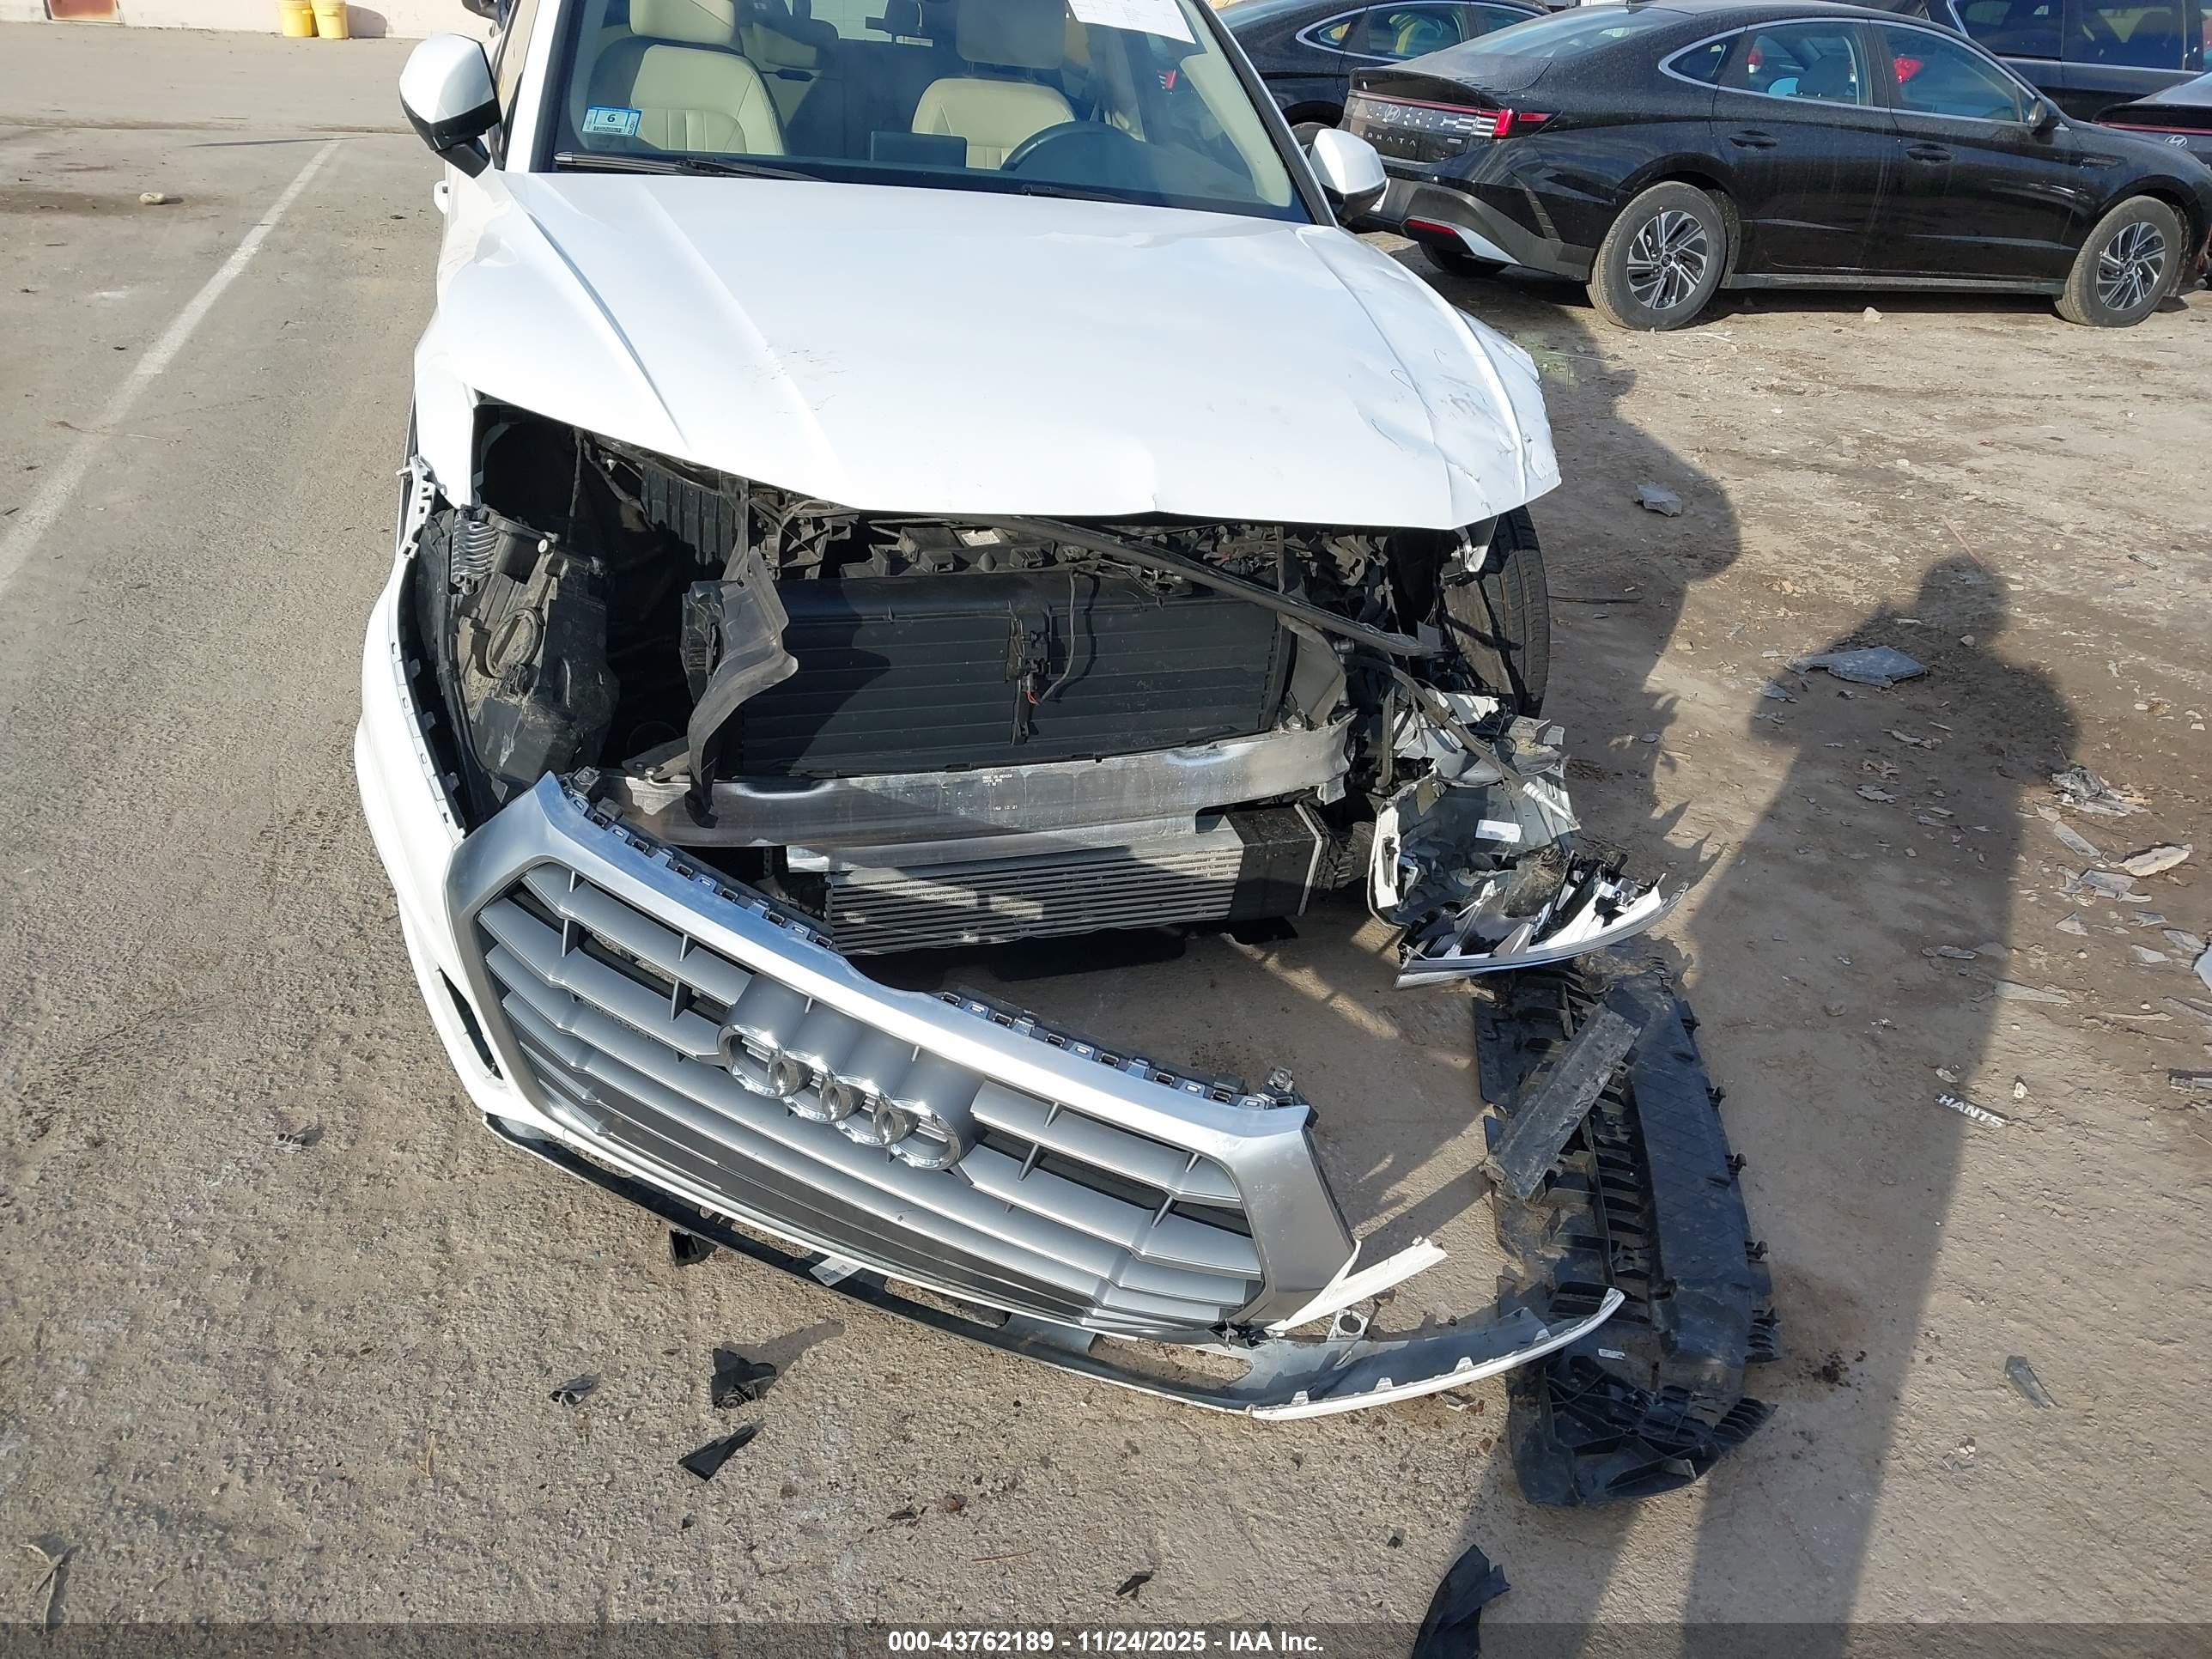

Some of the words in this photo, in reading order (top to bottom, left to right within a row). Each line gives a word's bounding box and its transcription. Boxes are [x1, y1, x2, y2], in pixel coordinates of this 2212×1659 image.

[606, 113, 616, 123] 6
[1358, 130, 1416, 147] SONATA
[1935, 1092, 2005, 1127] HANTS
